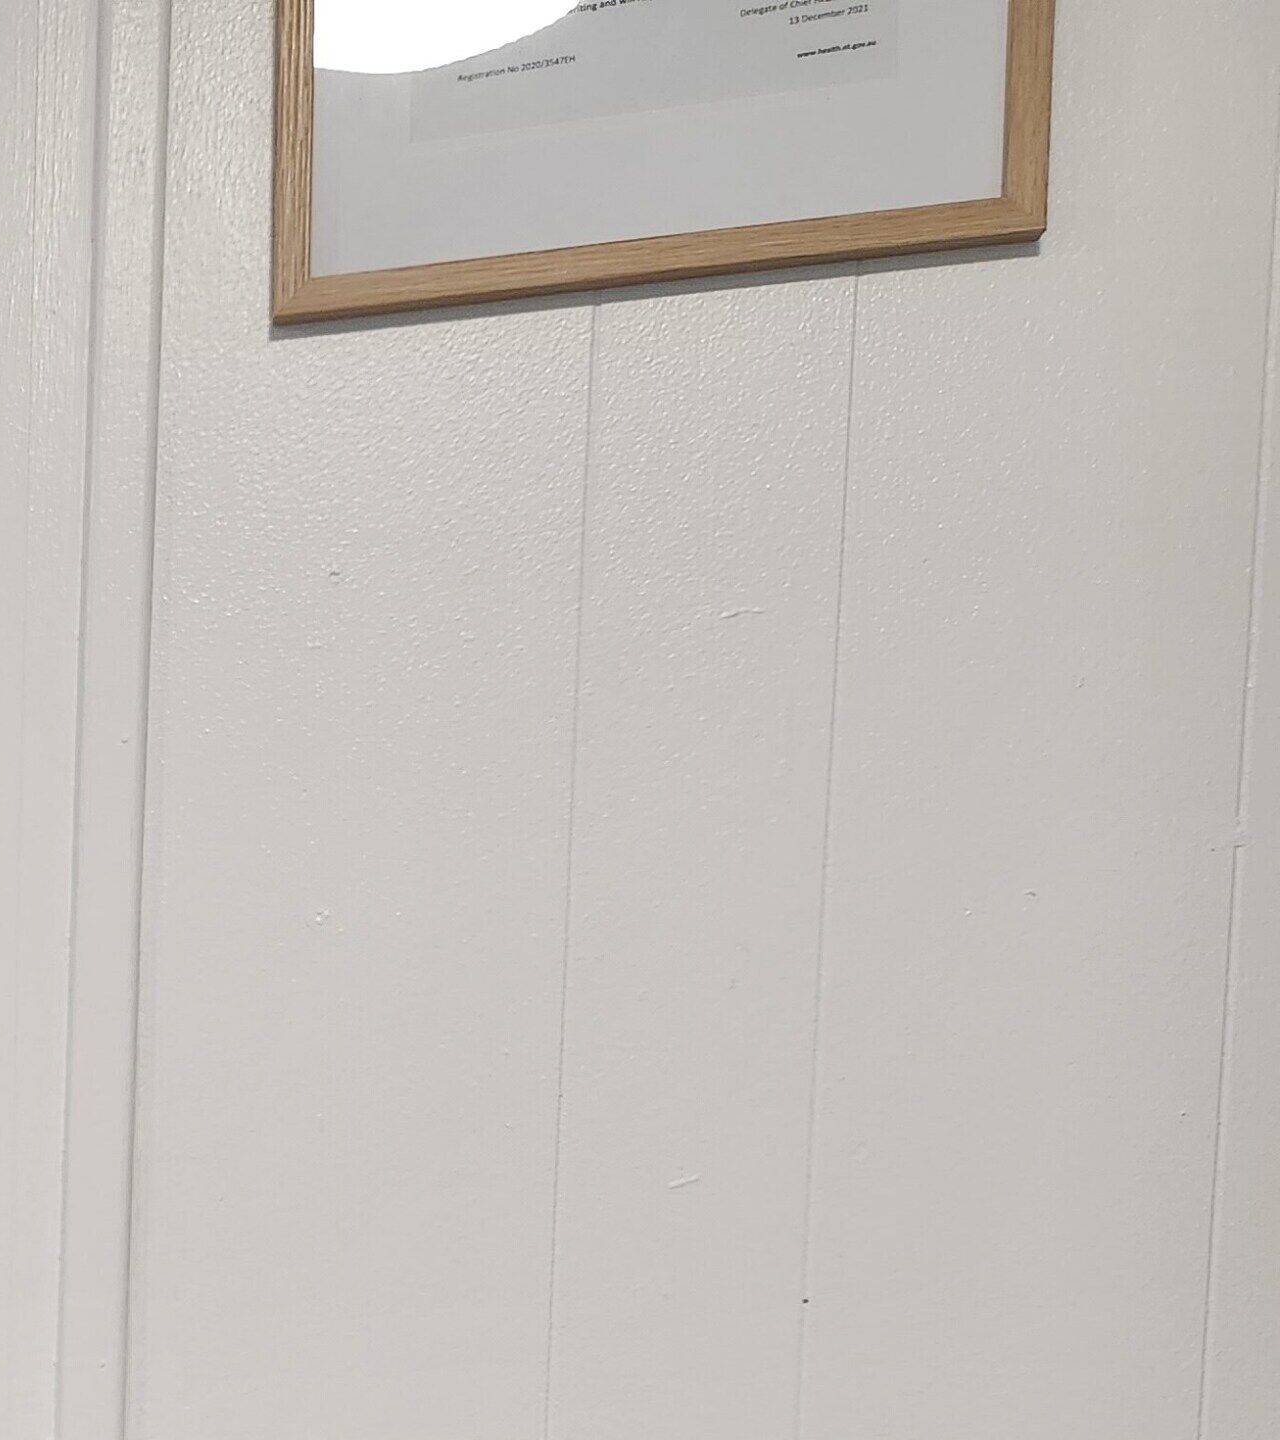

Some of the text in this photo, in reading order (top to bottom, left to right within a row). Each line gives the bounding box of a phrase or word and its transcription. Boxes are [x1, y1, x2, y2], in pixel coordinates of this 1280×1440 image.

[740, 5, 777, 17] Delegate
[779, 2, 789, 10] of
[802, 9, 845, 22] December
[847, 5, 868, 15] 2021
[457, 67, 505, 82] Registration
[507, 65, 519, 74] No
